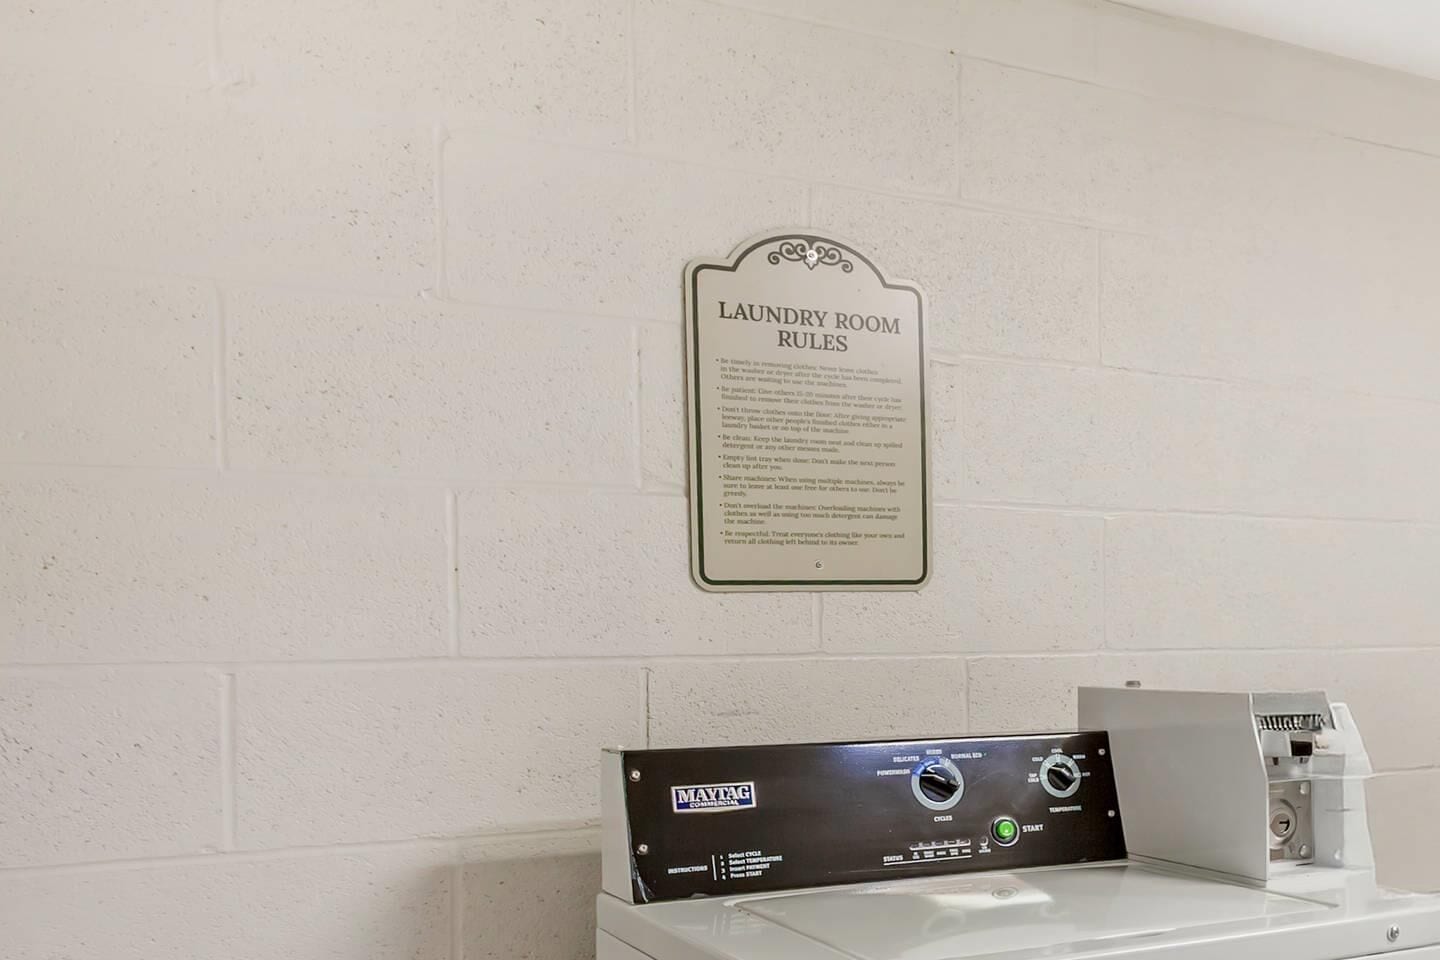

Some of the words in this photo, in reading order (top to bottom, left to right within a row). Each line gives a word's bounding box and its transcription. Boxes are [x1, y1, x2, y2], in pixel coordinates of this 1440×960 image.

[718, 301, 828, 328] LAUNDRY
[835, 312, 901, 335] ROOM
[777, 330, 848, 352] RULES
[677, 786, 751, 804] MAYTAG
[689, 799, 740, 808] COMMERCIAL
[1023, 824, 1044, 833] START
[883, 855, 904, 863] STATUS
[667, 865, 709, 874] INSTRUCTIONS
